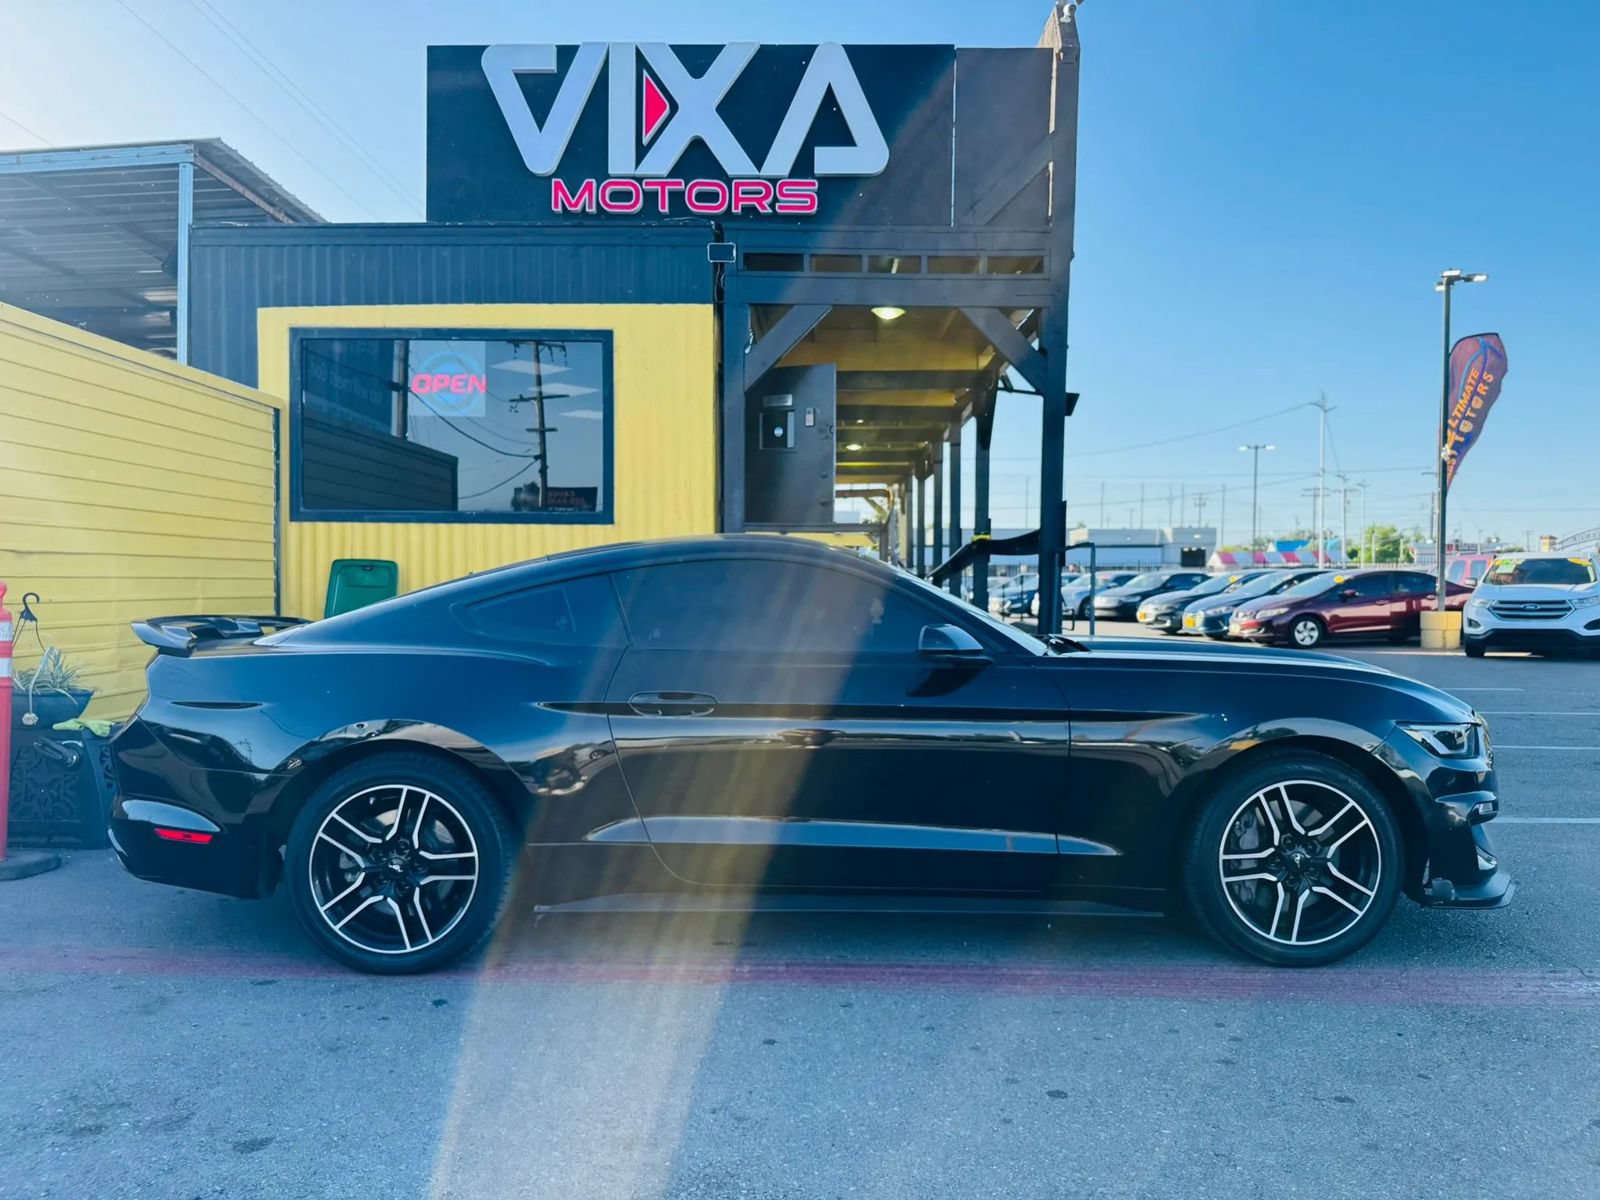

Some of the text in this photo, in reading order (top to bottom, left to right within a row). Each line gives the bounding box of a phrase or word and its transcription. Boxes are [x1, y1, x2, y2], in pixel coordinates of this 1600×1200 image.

[481, 42, 889, 177] VIXA
[550, 178, 819, 215] MOTORS
[411, 373, 486, 394] OPEN
